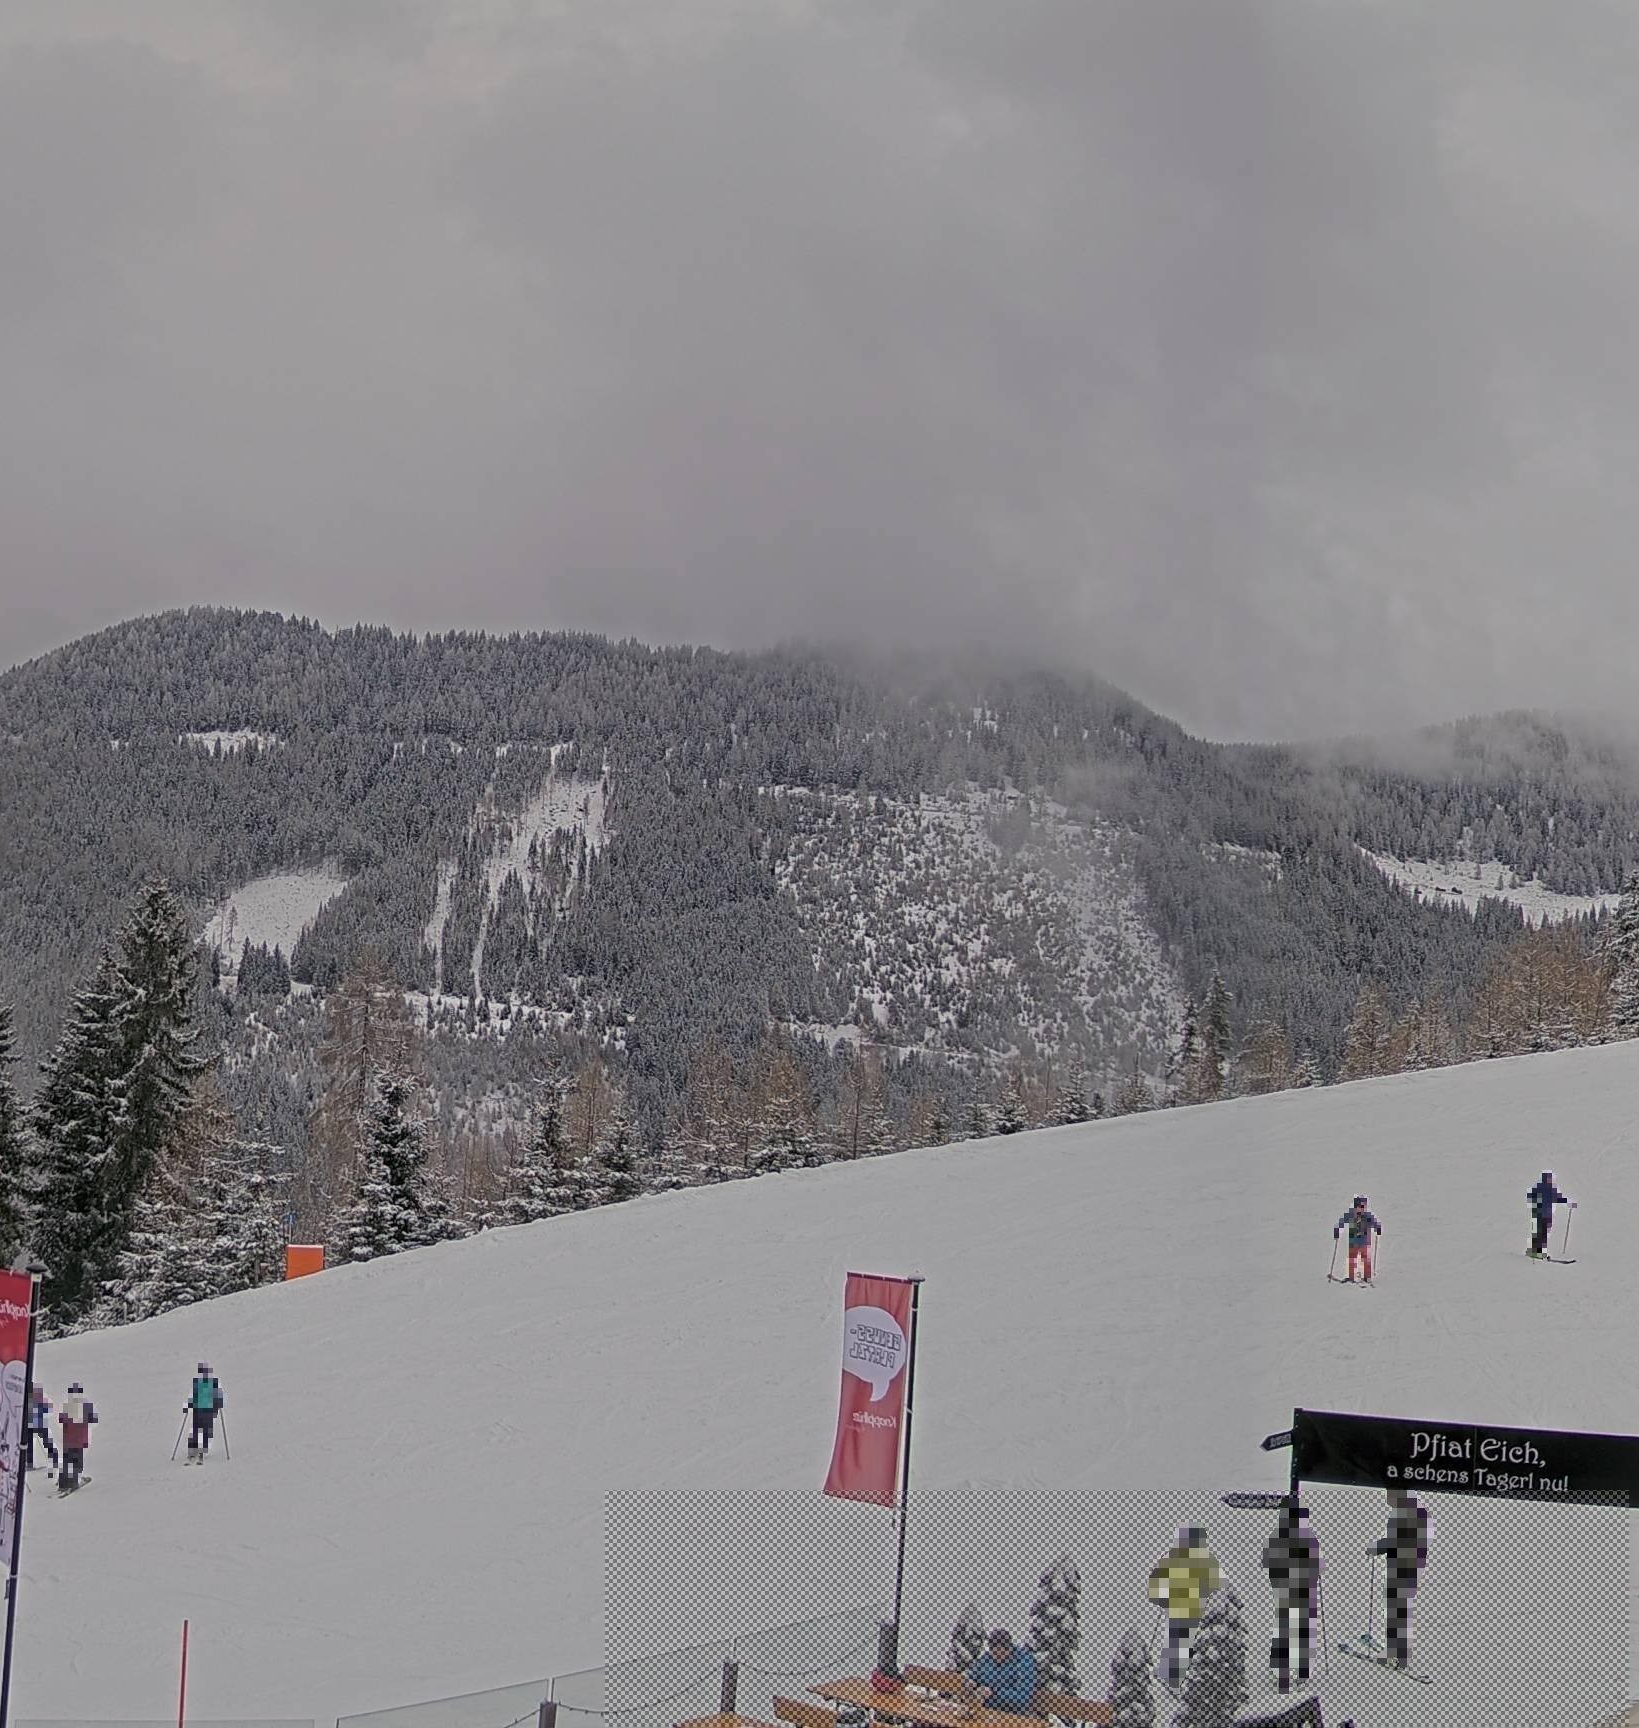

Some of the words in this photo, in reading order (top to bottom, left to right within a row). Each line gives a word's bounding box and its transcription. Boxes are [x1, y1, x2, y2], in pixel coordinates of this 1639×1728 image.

[1410, 1432, 1471, 1462] Pfiat
[1480, 1438, 1546, 1468] Eich,
[1387, 1465, 1398, 1478] a
[1403, 1464, 1469, 1484] schens
[1474, 1468, 1533, 1491] Tagerl
[1539, 1475, 1569, 1491] nu!
